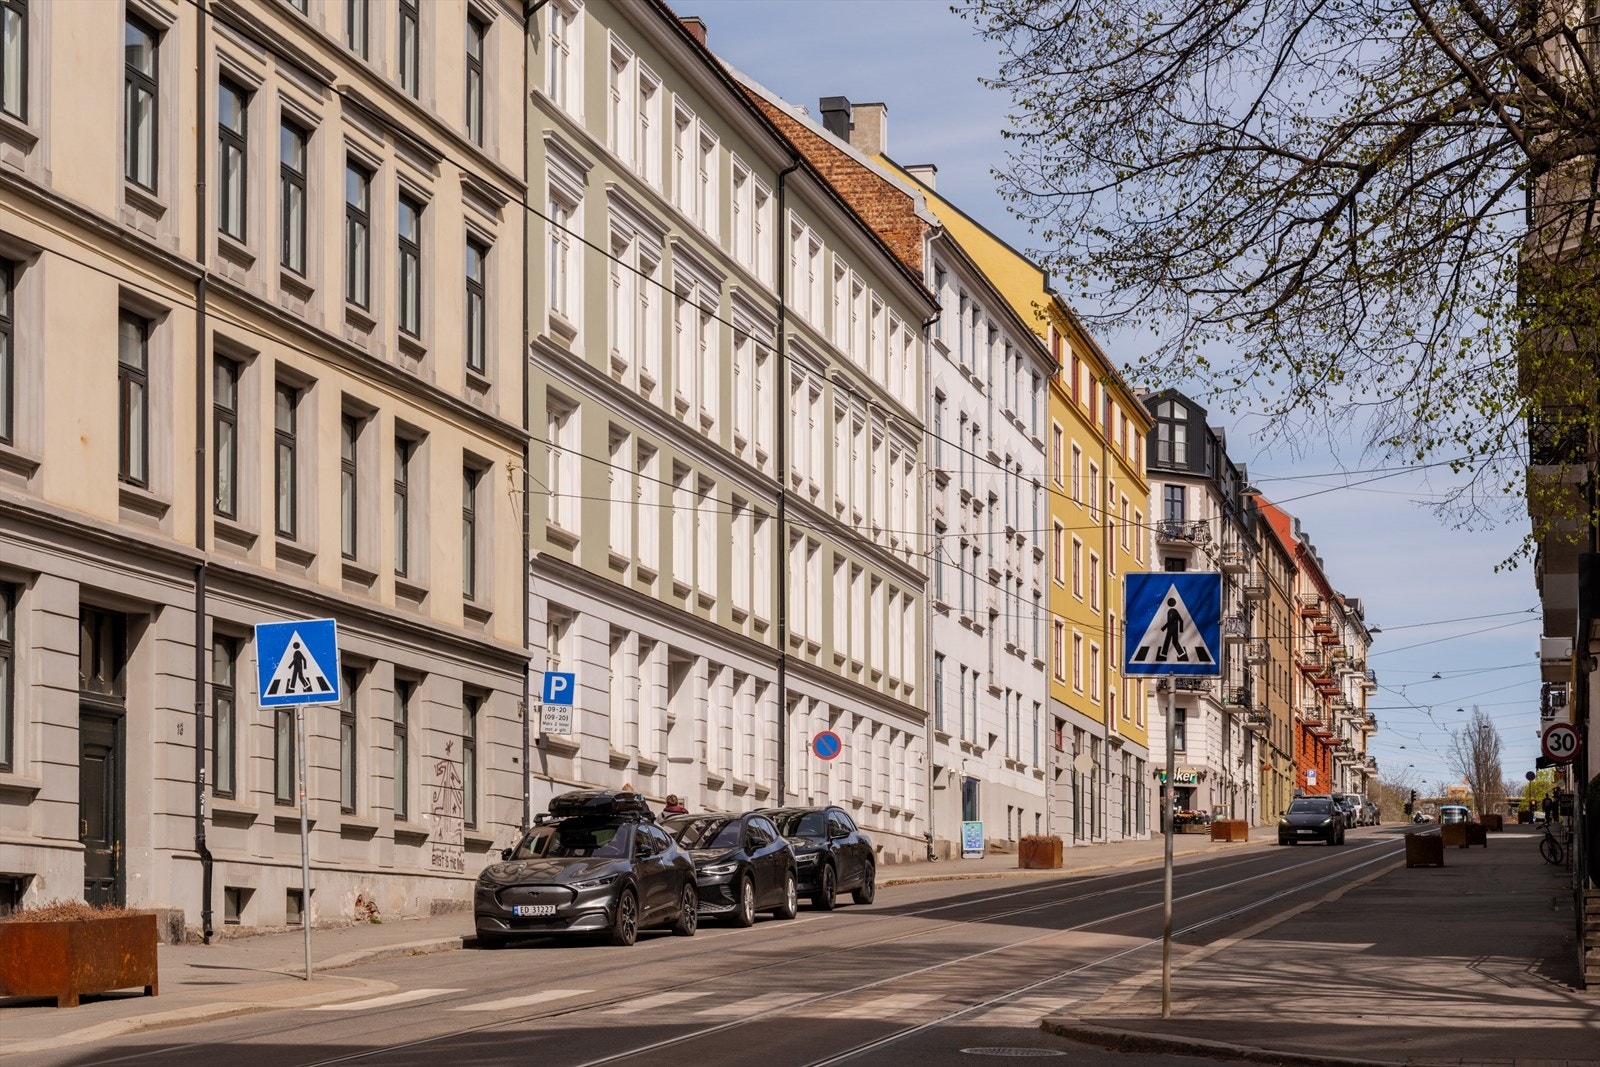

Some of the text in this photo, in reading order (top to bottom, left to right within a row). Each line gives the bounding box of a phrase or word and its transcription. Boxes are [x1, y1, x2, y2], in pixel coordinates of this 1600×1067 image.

[550, 676, 567, 700] P
[1549, 732, 1575, 752] 30
[1163, 767, 1196, 783] ker
[520, 905, 554, 914] ED 31227
